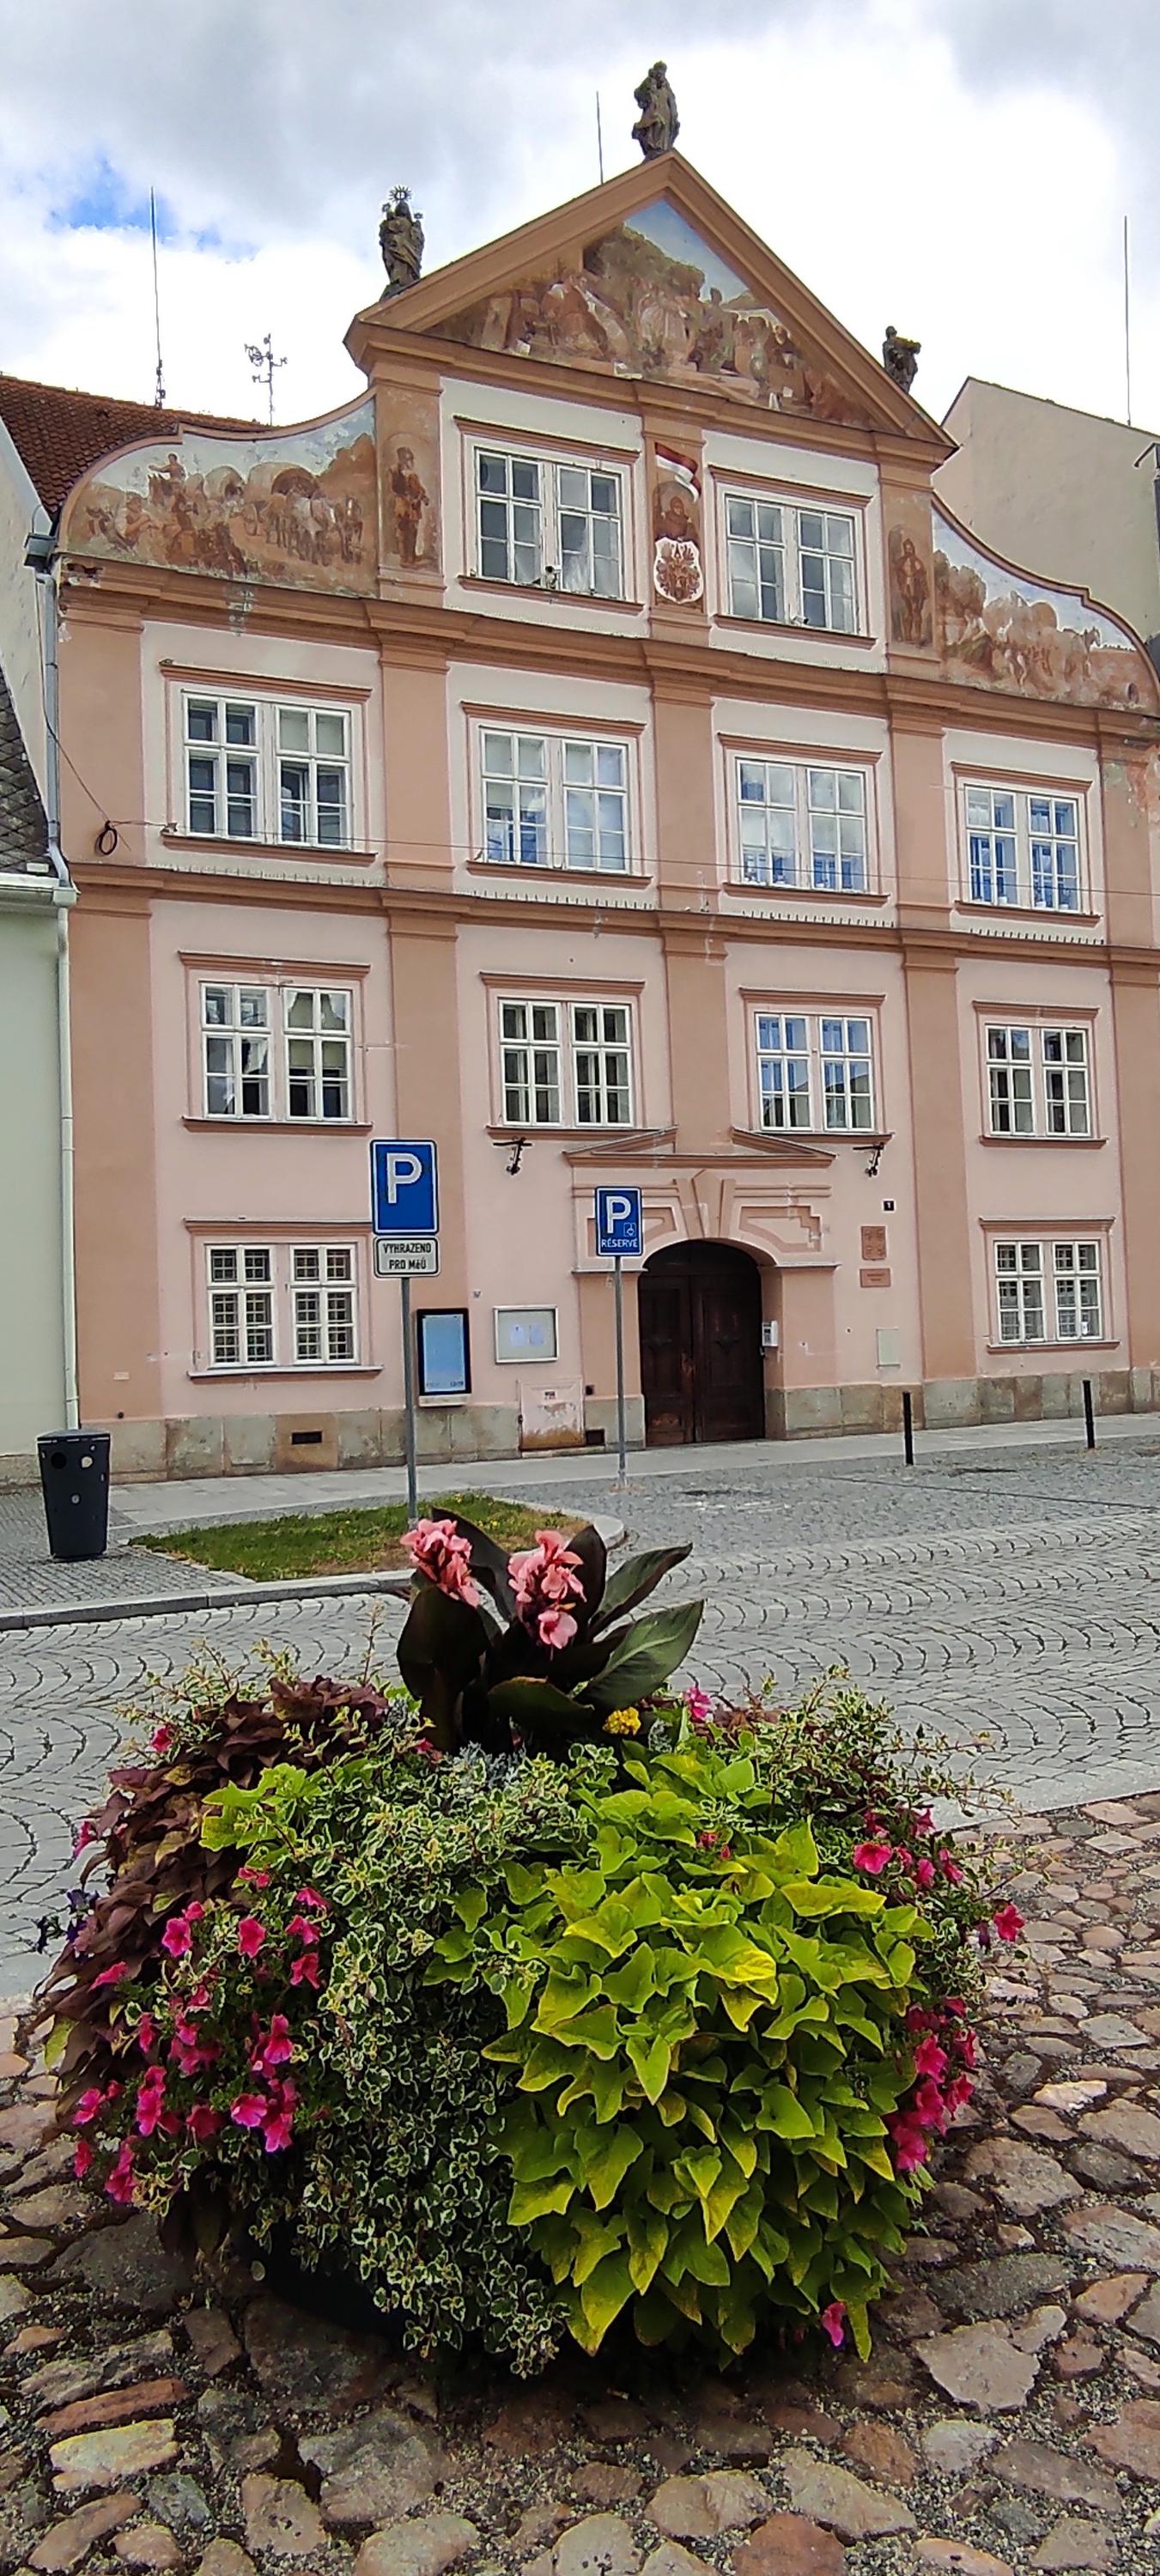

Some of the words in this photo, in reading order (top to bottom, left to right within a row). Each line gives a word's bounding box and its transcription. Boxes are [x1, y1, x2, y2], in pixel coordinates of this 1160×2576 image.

[386, 1152, 422, 1204] P
[606, 1196, 631, 1234] P
[382, 1242, 432, 1254] VYHRAZENO
[601, 1237, 638, 1248] RÉSERVÉ
[389, 1259, 406, 1270] PRO
